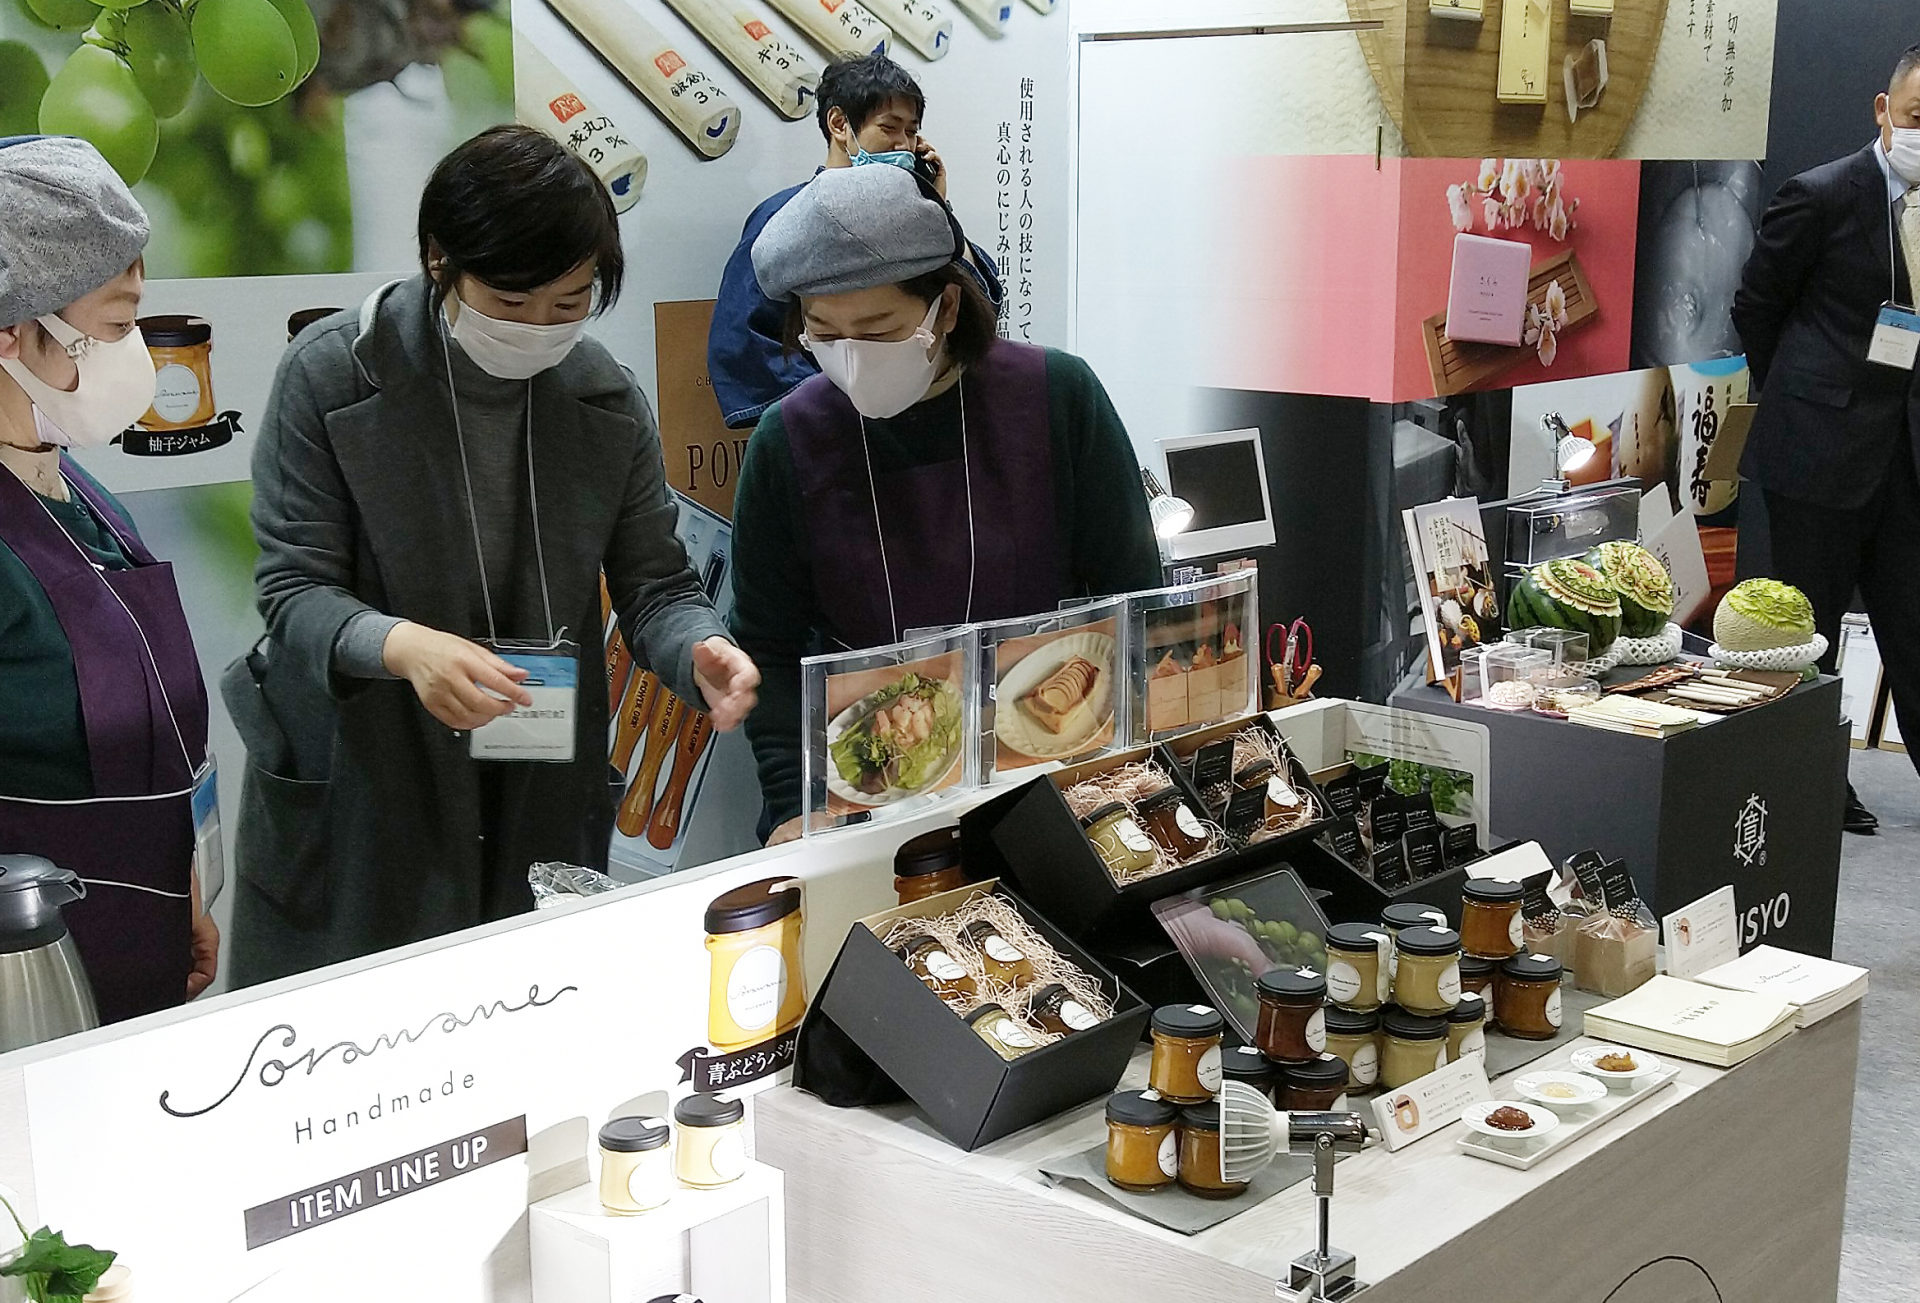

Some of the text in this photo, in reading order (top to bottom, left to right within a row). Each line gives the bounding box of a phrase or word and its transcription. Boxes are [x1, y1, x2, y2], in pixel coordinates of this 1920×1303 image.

[148, 435, 211, 453] 柚子ジャム
[664, 693, 677, 717] OWER
[692, 713, 705, 735] OWER
[294, 1070, 476, 1144] Handmade
[289, 1135, 489, 1229] ITEM LINE UP
